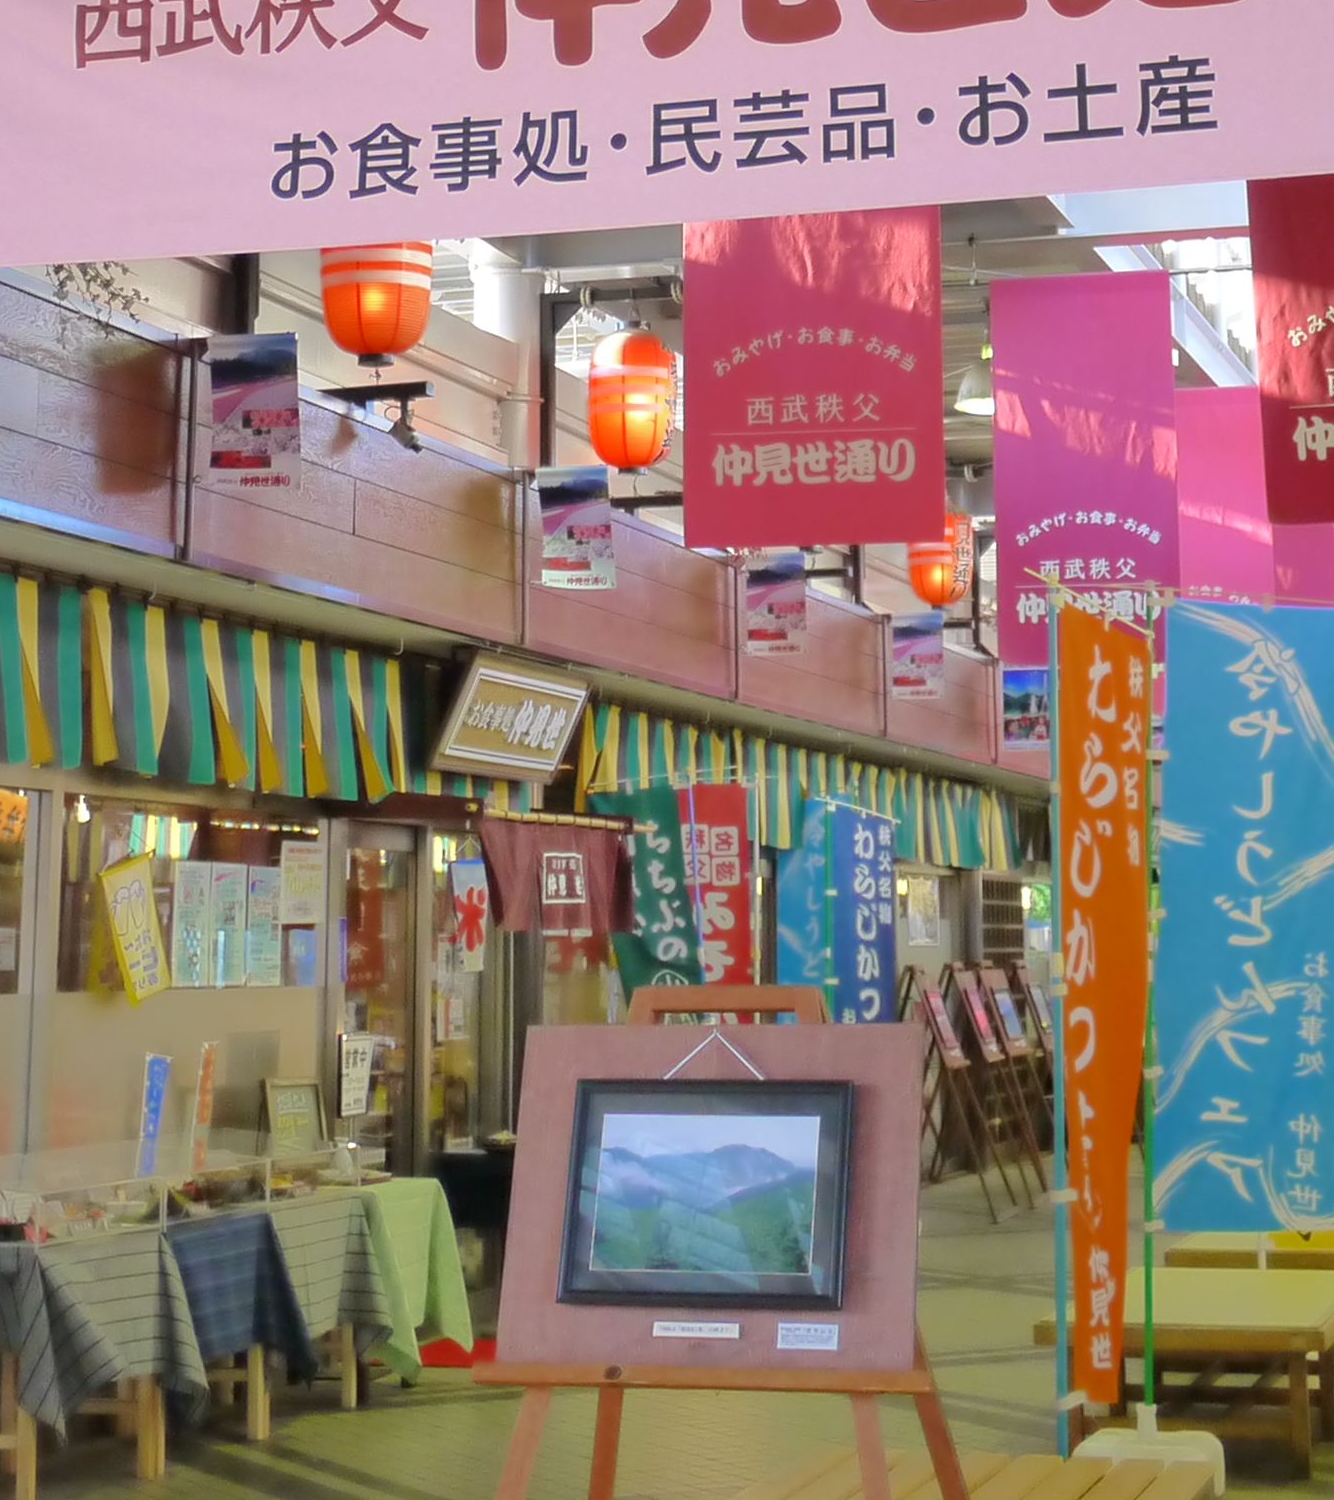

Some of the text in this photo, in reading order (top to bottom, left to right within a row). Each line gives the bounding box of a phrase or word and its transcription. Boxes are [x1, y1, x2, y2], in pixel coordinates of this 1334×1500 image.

[269, 54, 1220, 201] お食事処・民芸品・お土産
[711, 325, 917, 377] おみやげ・お食事・お弁当
[746, 393, 881, 426] 西武秩父
[711, 437, 916, 486] 仲見世通り
[1039, 557, 1137, 580] 西武秩父
[853, 823, 881, 1022] わらじかつ
